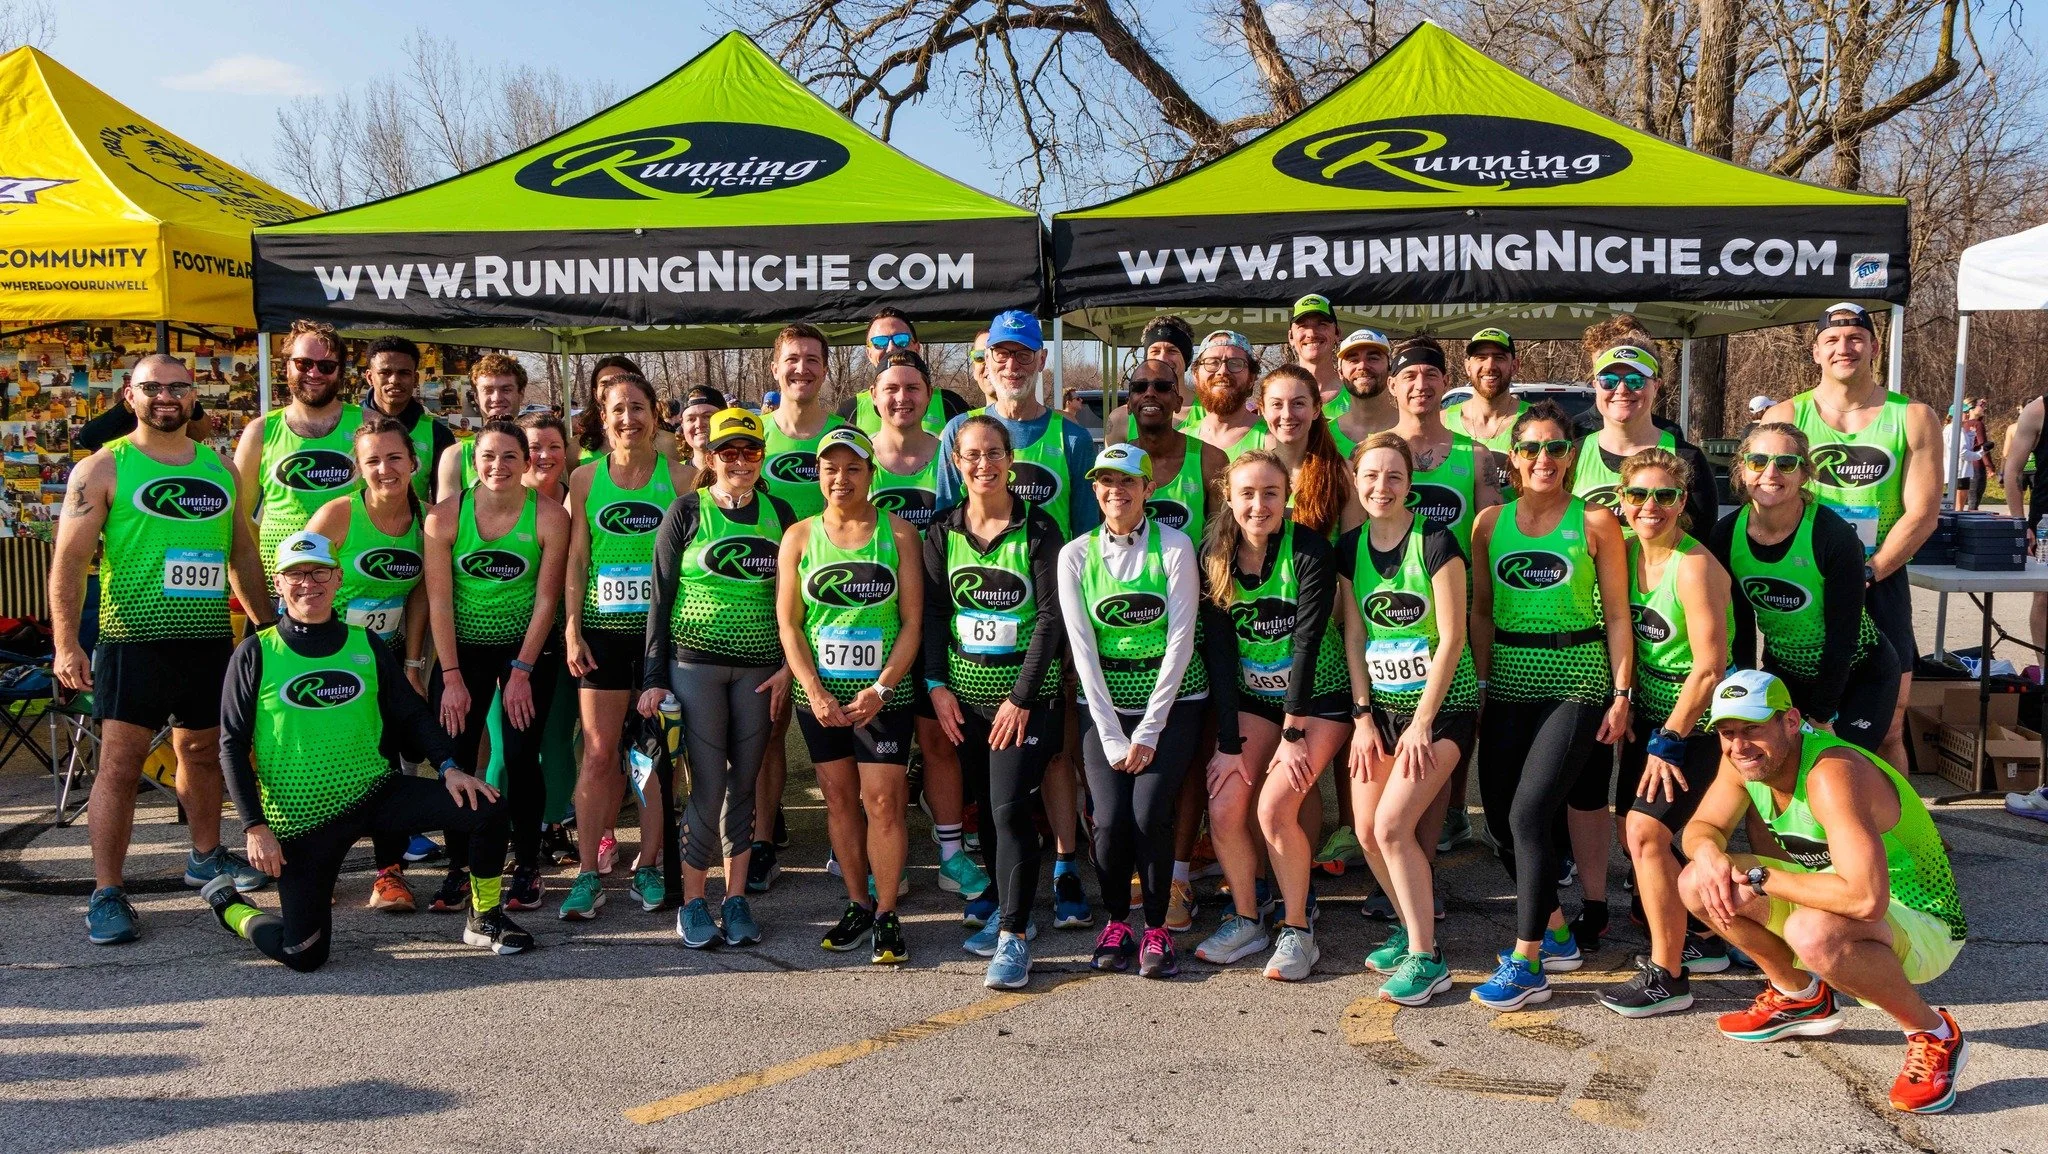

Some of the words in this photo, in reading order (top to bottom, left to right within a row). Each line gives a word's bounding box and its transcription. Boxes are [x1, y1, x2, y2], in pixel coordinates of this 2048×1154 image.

[551, 136, 820, 200] Running
[1304, 128, 1600, 192] Running
[690, 176, 775, 187] NICHE
[1478, 170, 1569, 180] NICHE
[172, 250, 254, 279] FOOTWEAR
[282, 456, 350, 490] Running
[776, 456, 819, 482] Runni
[1811, 450, 1883, 489] Running
[1008, 470, 1052, 497] unning
[149, 483, 222, 519] Running
[603, 506, 658, 534] Running
[367, 553, 420, 580] Running
[466, 555, 520, 581] Running
[713, 542, 778, 580] Runnin
[1503, 557, 1561, 589] Running
[171, 565, 220, 587] 8997
[814, 568, 891, 607] Running
[603, 580, 651, 601] 8956
[952, 572, 1020, 611] Running
[1746, 582, 1800, 611] Running
[1100, 600, 1161, 627] Running
[1368, 596, 1420, 627] Running
[974, 620, 996, 641] 63
[1265, 626, 1287, 636] NICHE
[825, 644, 875, 666] 5790
[1373, 656, 1427, 680] 5986
[292, 677, 355, 707] Running
